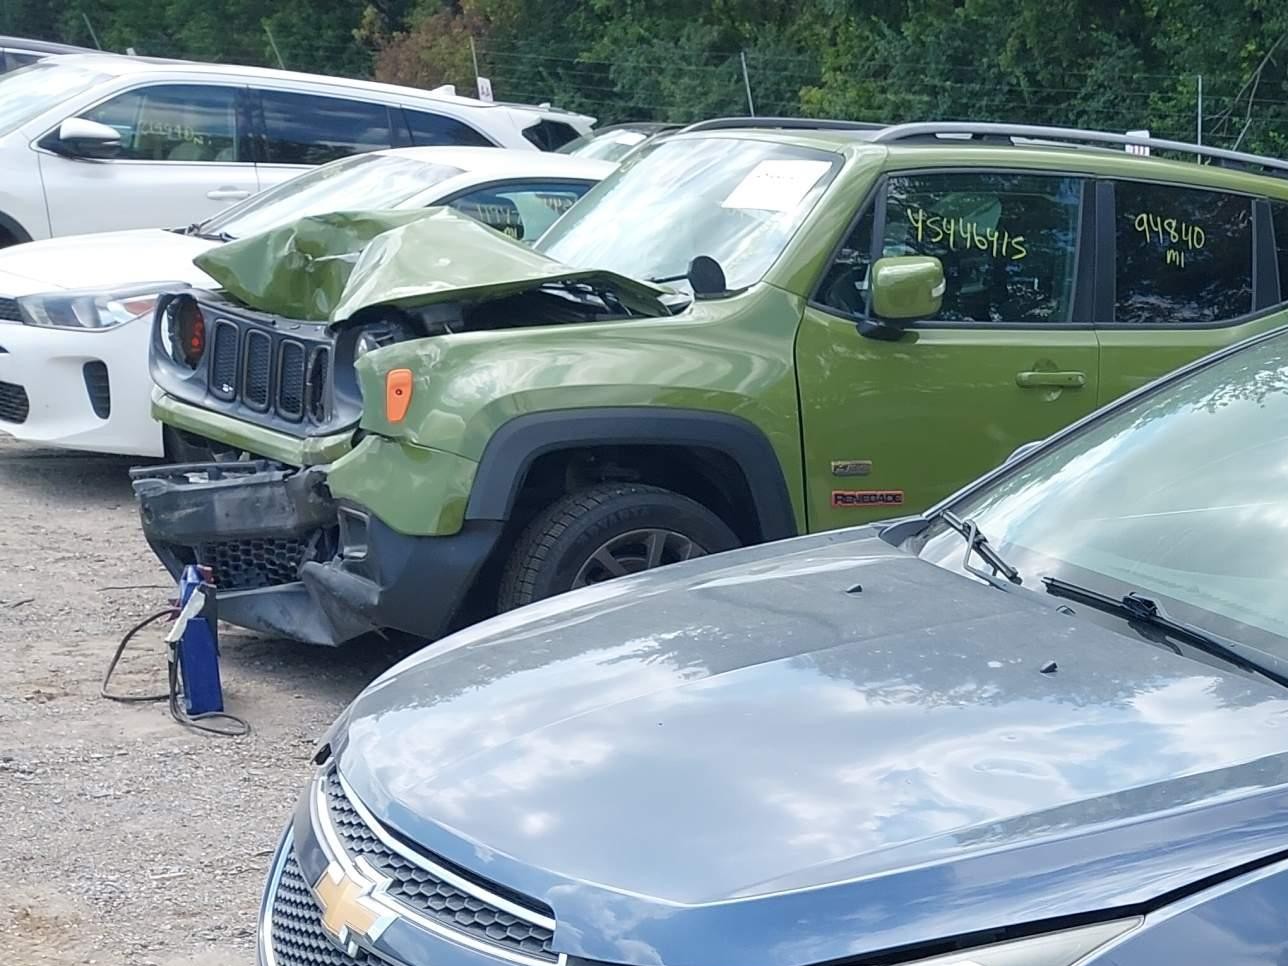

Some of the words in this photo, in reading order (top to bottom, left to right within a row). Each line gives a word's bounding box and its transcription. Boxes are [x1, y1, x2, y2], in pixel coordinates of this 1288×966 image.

[907, 208, 1027, 260] 45446415
[1135, 213, 1206, 249] 94840
[832, 490, 904, 506] RENEGADE
